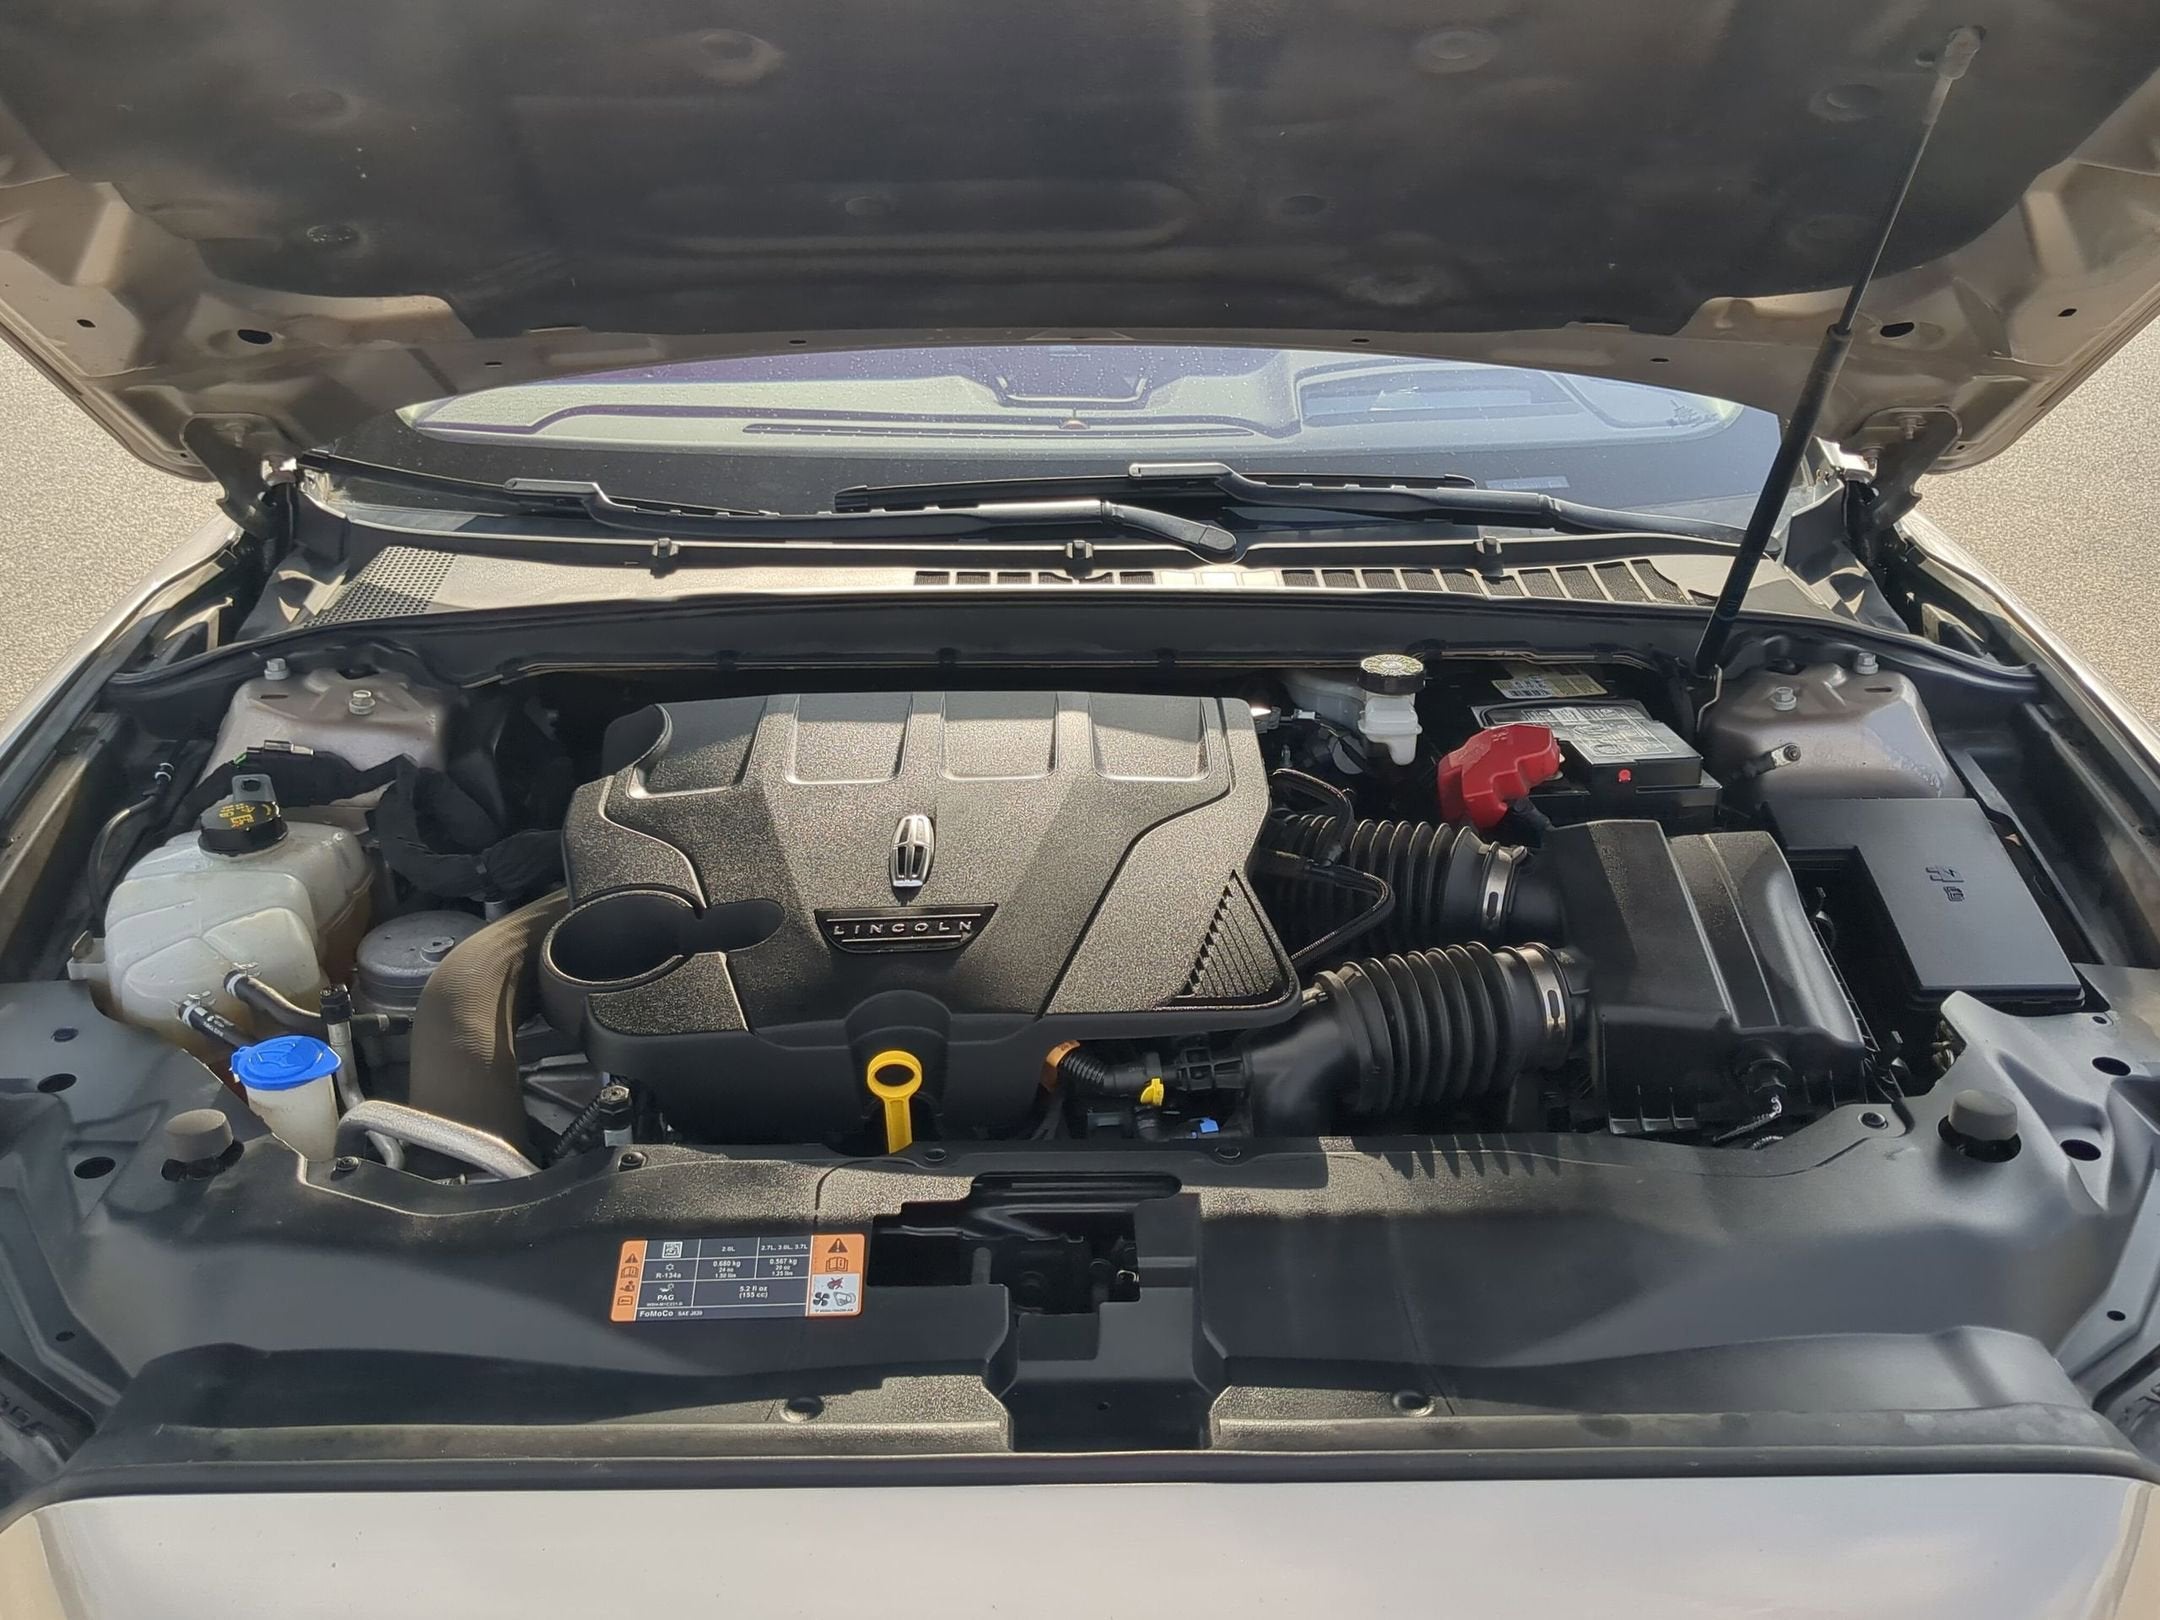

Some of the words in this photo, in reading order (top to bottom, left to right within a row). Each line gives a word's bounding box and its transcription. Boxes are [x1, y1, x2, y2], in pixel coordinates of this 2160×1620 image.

[833, 921, 972, 935] LINCOLN
[732, 1260, 741, 1268] kg
[788, 1258, 798, 1266] kg
